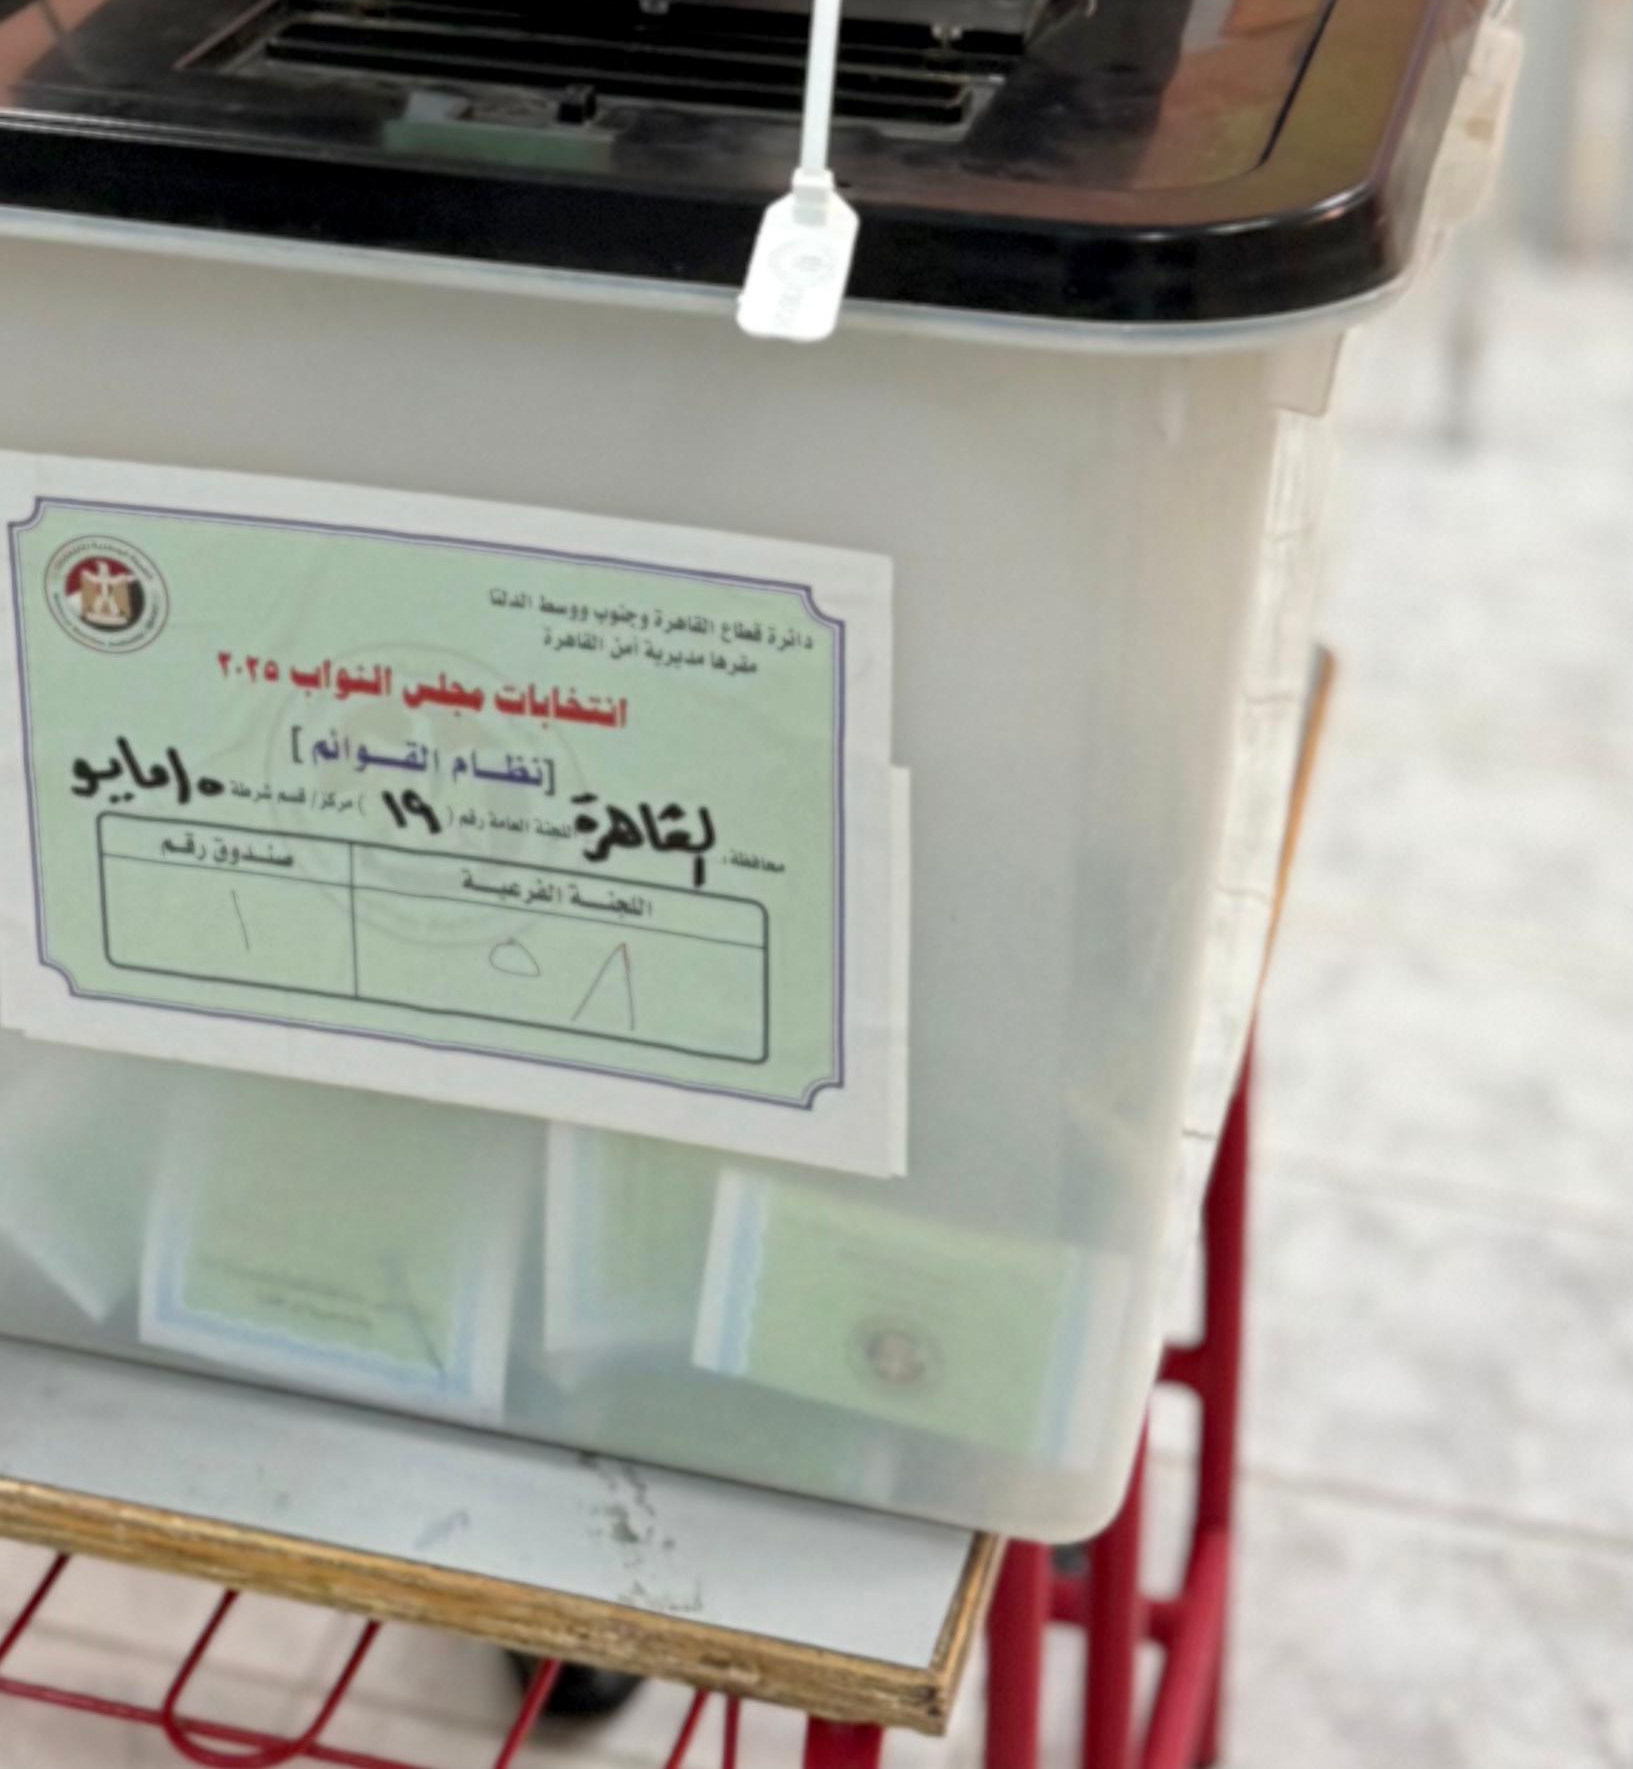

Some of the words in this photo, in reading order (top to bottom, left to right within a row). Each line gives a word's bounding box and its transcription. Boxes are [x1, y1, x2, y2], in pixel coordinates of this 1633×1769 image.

[489, 586, 533, 610] الدلتا
[653, 608, 715, 635] القاهرة
[719, 621, 763, 644] قطاع
[543, 627, 604, 652] القاهرة
[643, 639, 705, 667] مديرية
[217, 650, 280, 683] ٢٠٢٥
[289, 658, 393, 700] النواب
[401, 670, 486, 718] مجلس
[493, 681, 628, 730] انتخابات
[160, 829, 207, 862] رقم
[212, 835, 295, 869] صندوق
